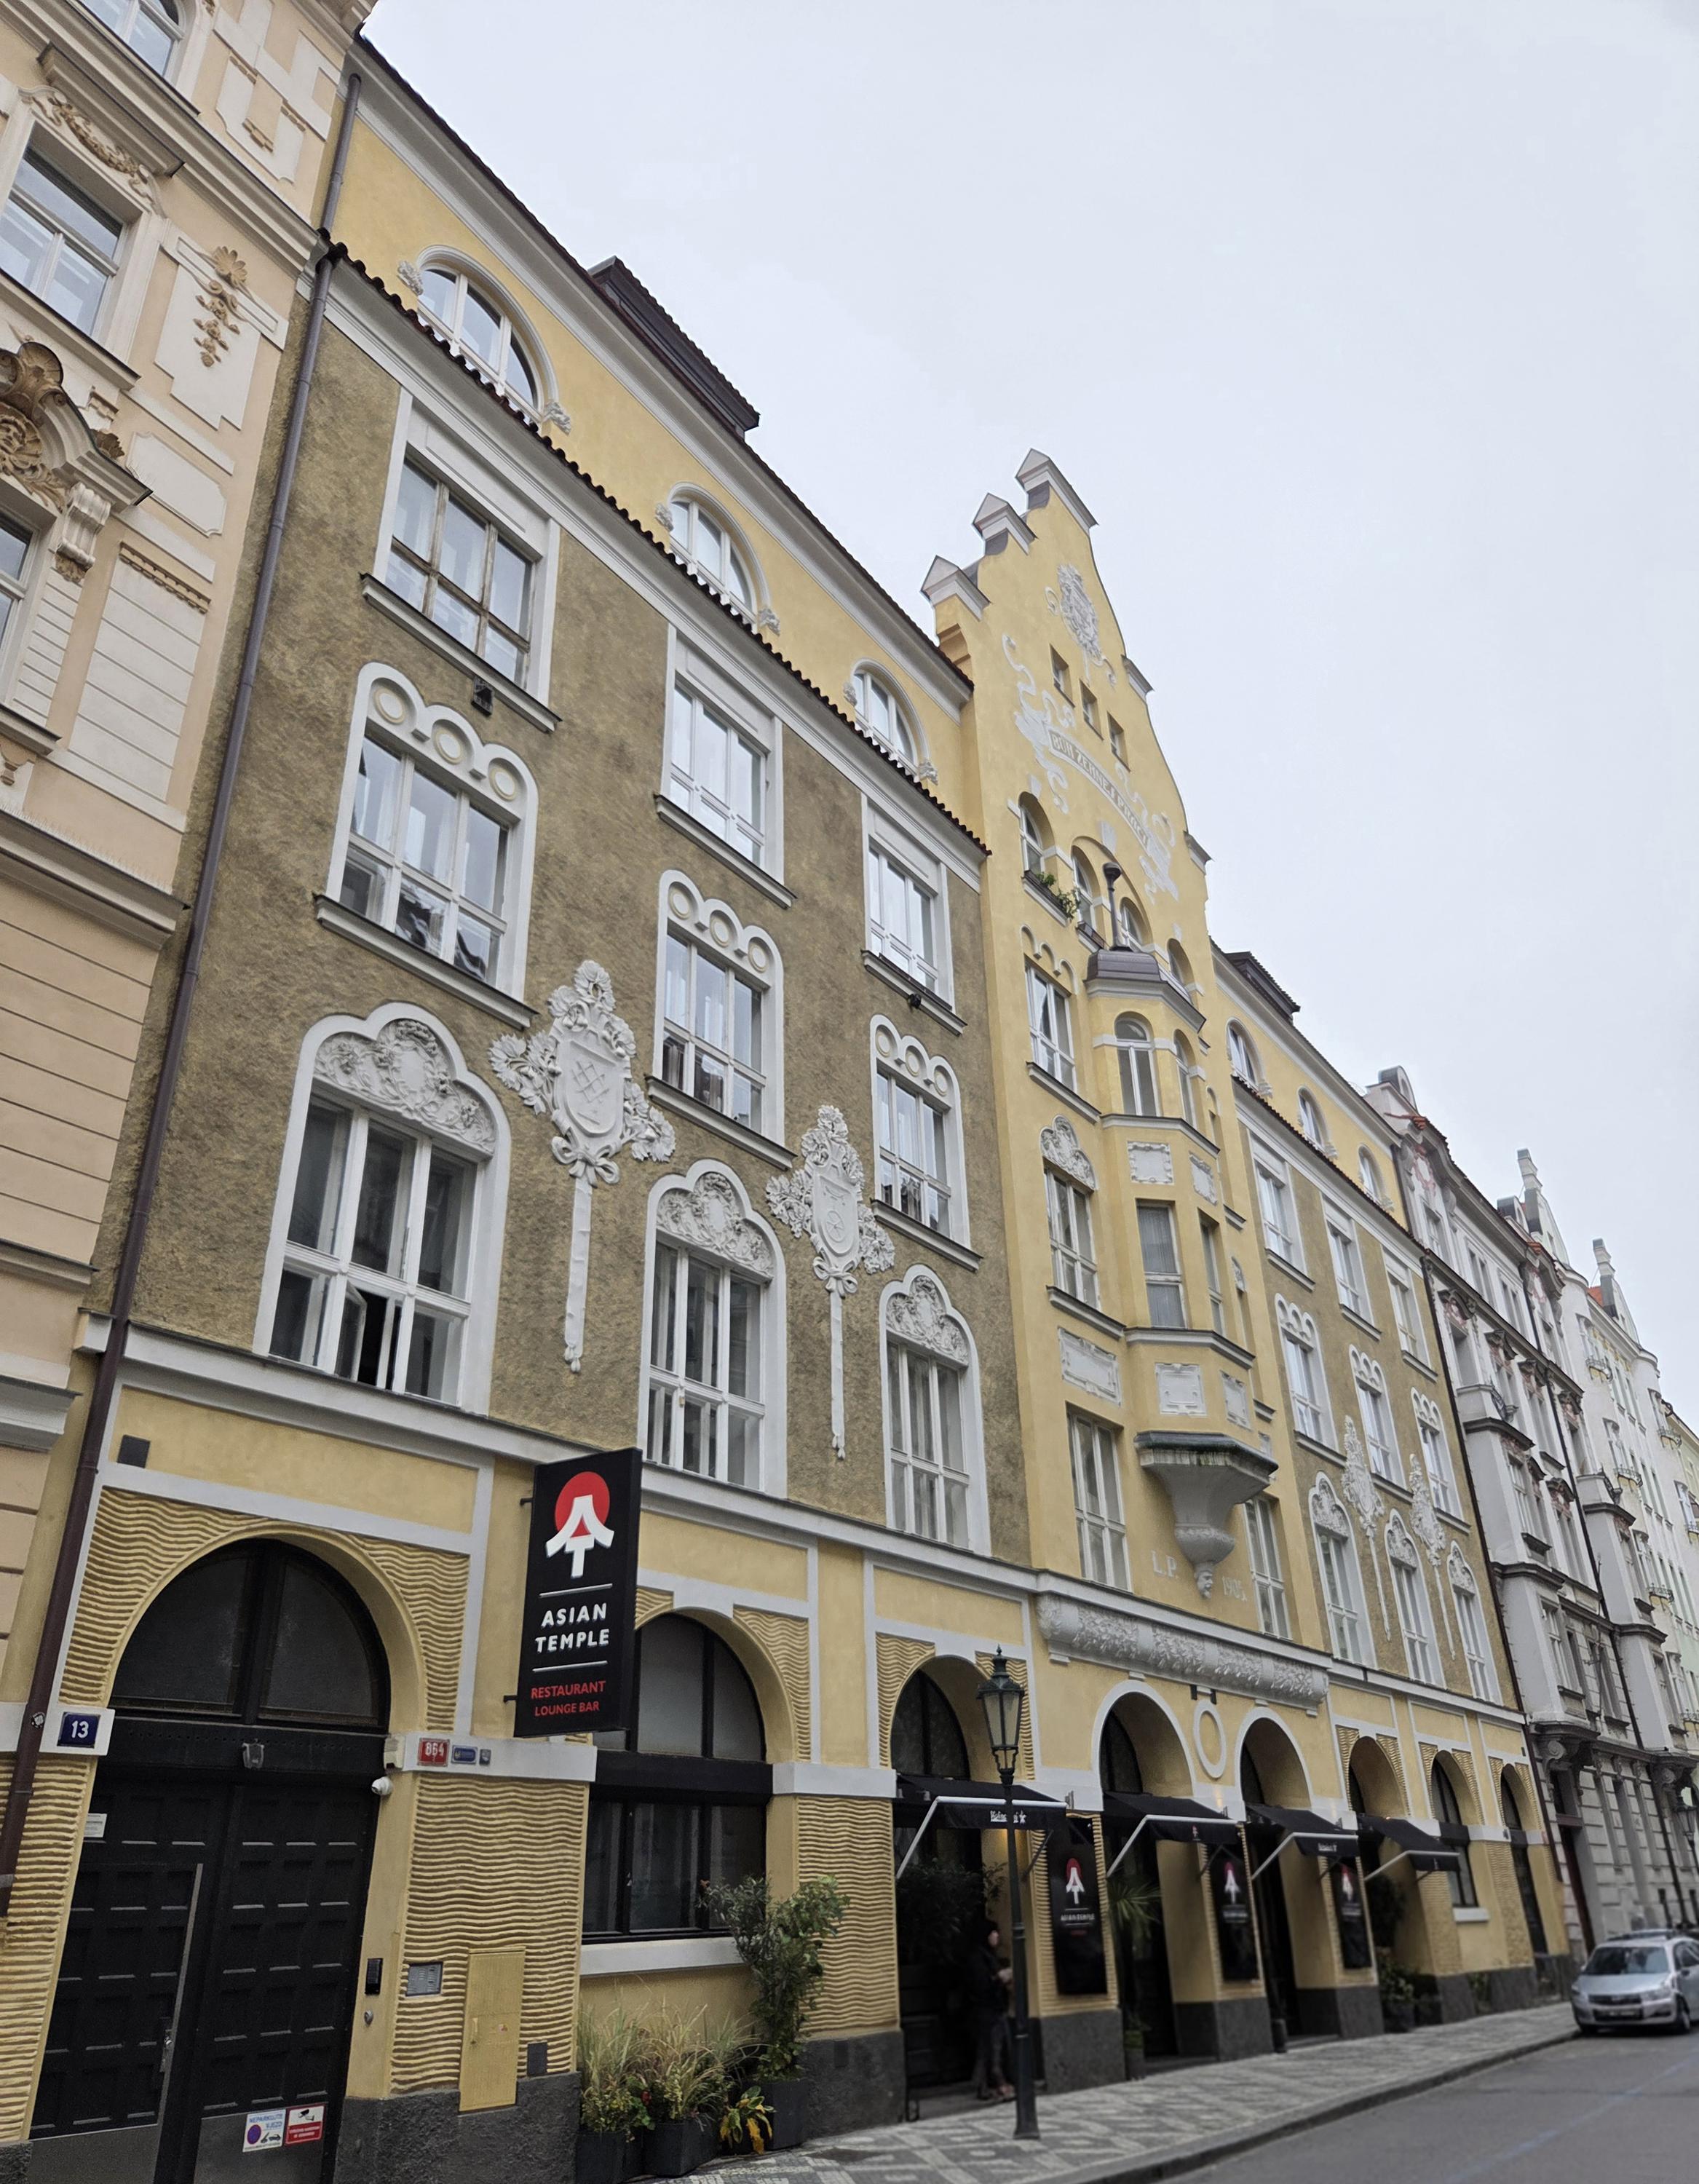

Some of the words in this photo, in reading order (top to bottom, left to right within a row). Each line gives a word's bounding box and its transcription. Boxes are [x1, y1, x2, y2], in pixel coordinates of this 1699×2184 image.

[541, 1602, 607, 1628] ASIAN
[535, 1629, 610, 1653] TEMPLE
[531, 1680, 606, 1699] RESTAURANT
[535, 1703, 577, 1717] LOUNGE
[579, 1701, 600, 1714] BAR
[71, 1720, 89, 1738] 13
